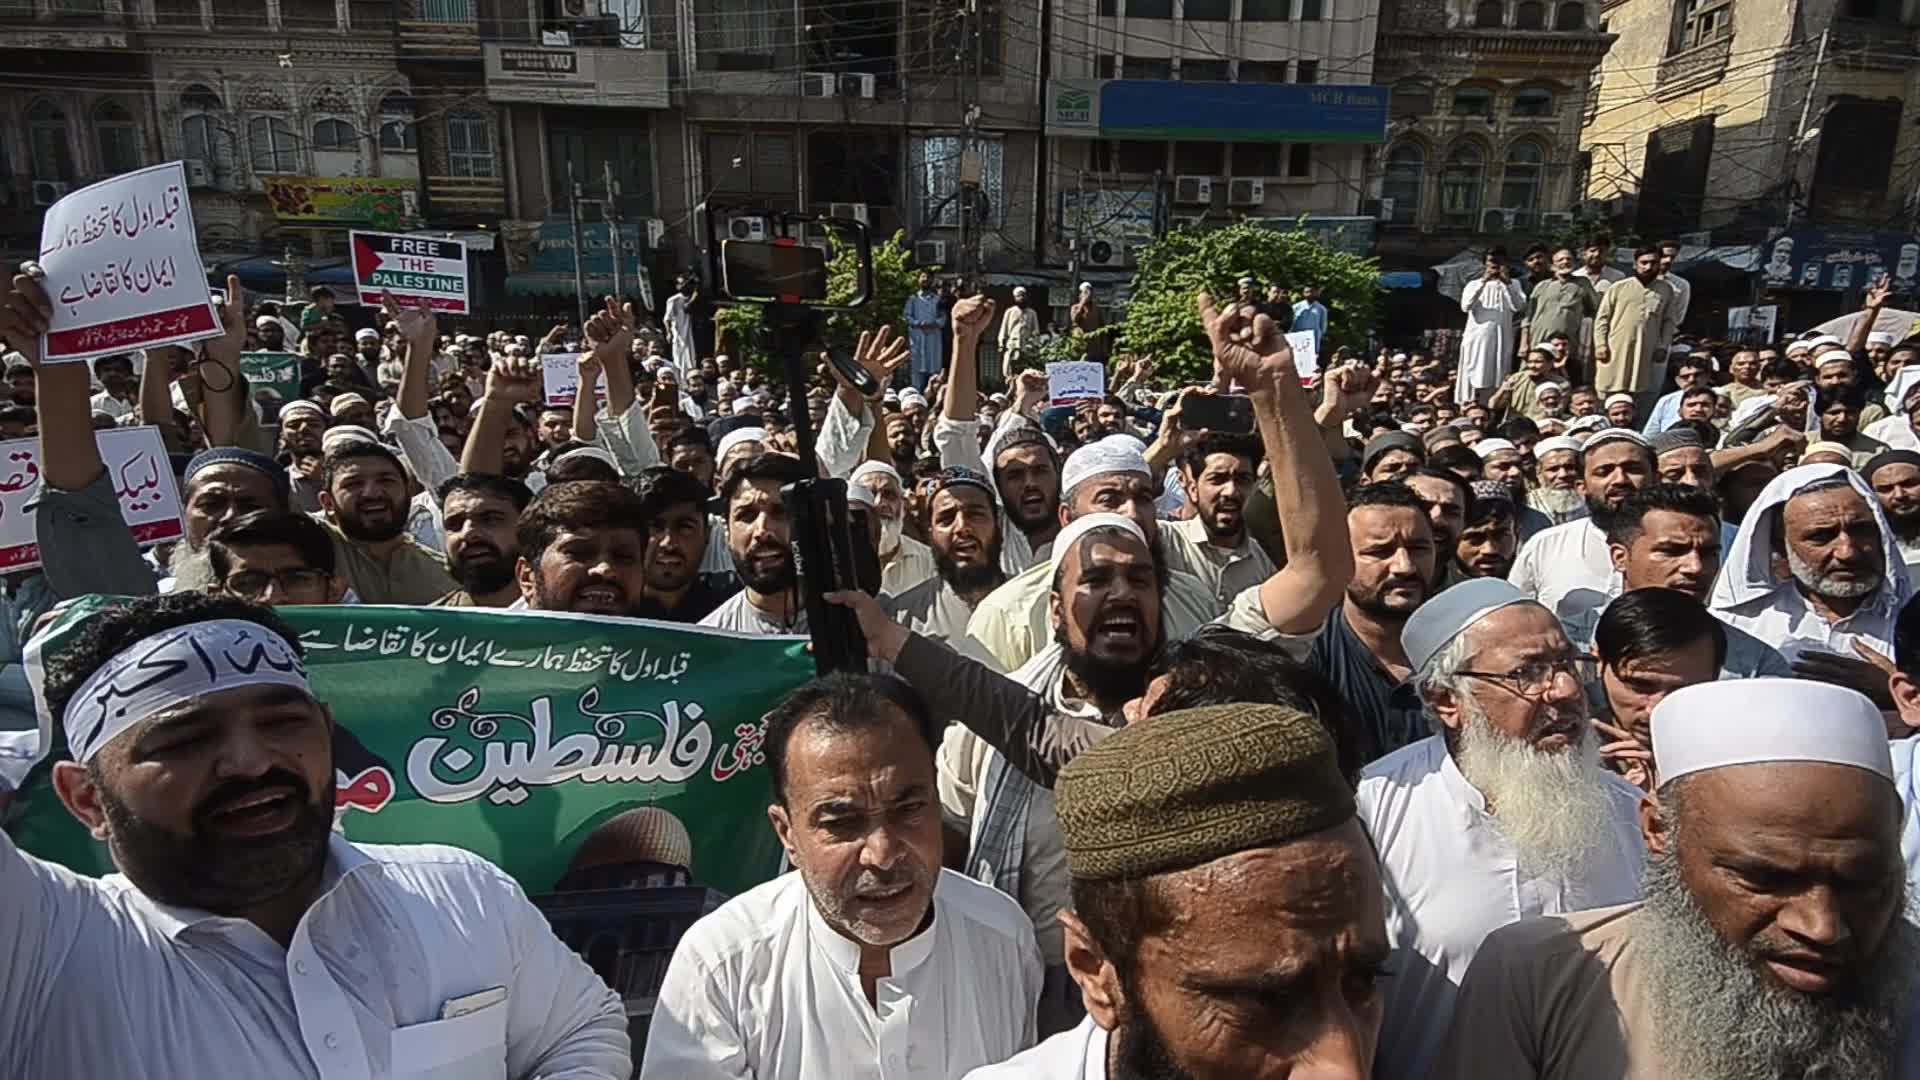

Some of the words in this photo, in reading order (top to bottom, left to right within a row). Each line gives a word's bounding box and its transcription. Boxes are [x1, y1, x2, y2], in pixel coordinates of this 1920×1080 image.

[154, 186, 181, 231] قبلہ
[81, 206, 111, 245] تحفظ
[391, 239, 440, 256] FREE
[119, 257, 133, 290] کا
[133, 256, 176, 294] ایمان
[398, 257, 435, 273] THE
[81, 264, 119, 299] تقاضا
[372, 273, 464, 291] PALESTINE
[343, 624, 406, 655] تقاضا
[409, 627, 439, 657] کا
[426, 639, 493, 667] ایمان
[488, 646, 564, 671] ہمارے
[564, 646, 610, 673] تحفظ
[607, 648, 631, 676] کا
[622, 648, 658, 681] اول
[658, 653, 692, 685] قبلہ
[406, 694, 712, 805] فلسطین
